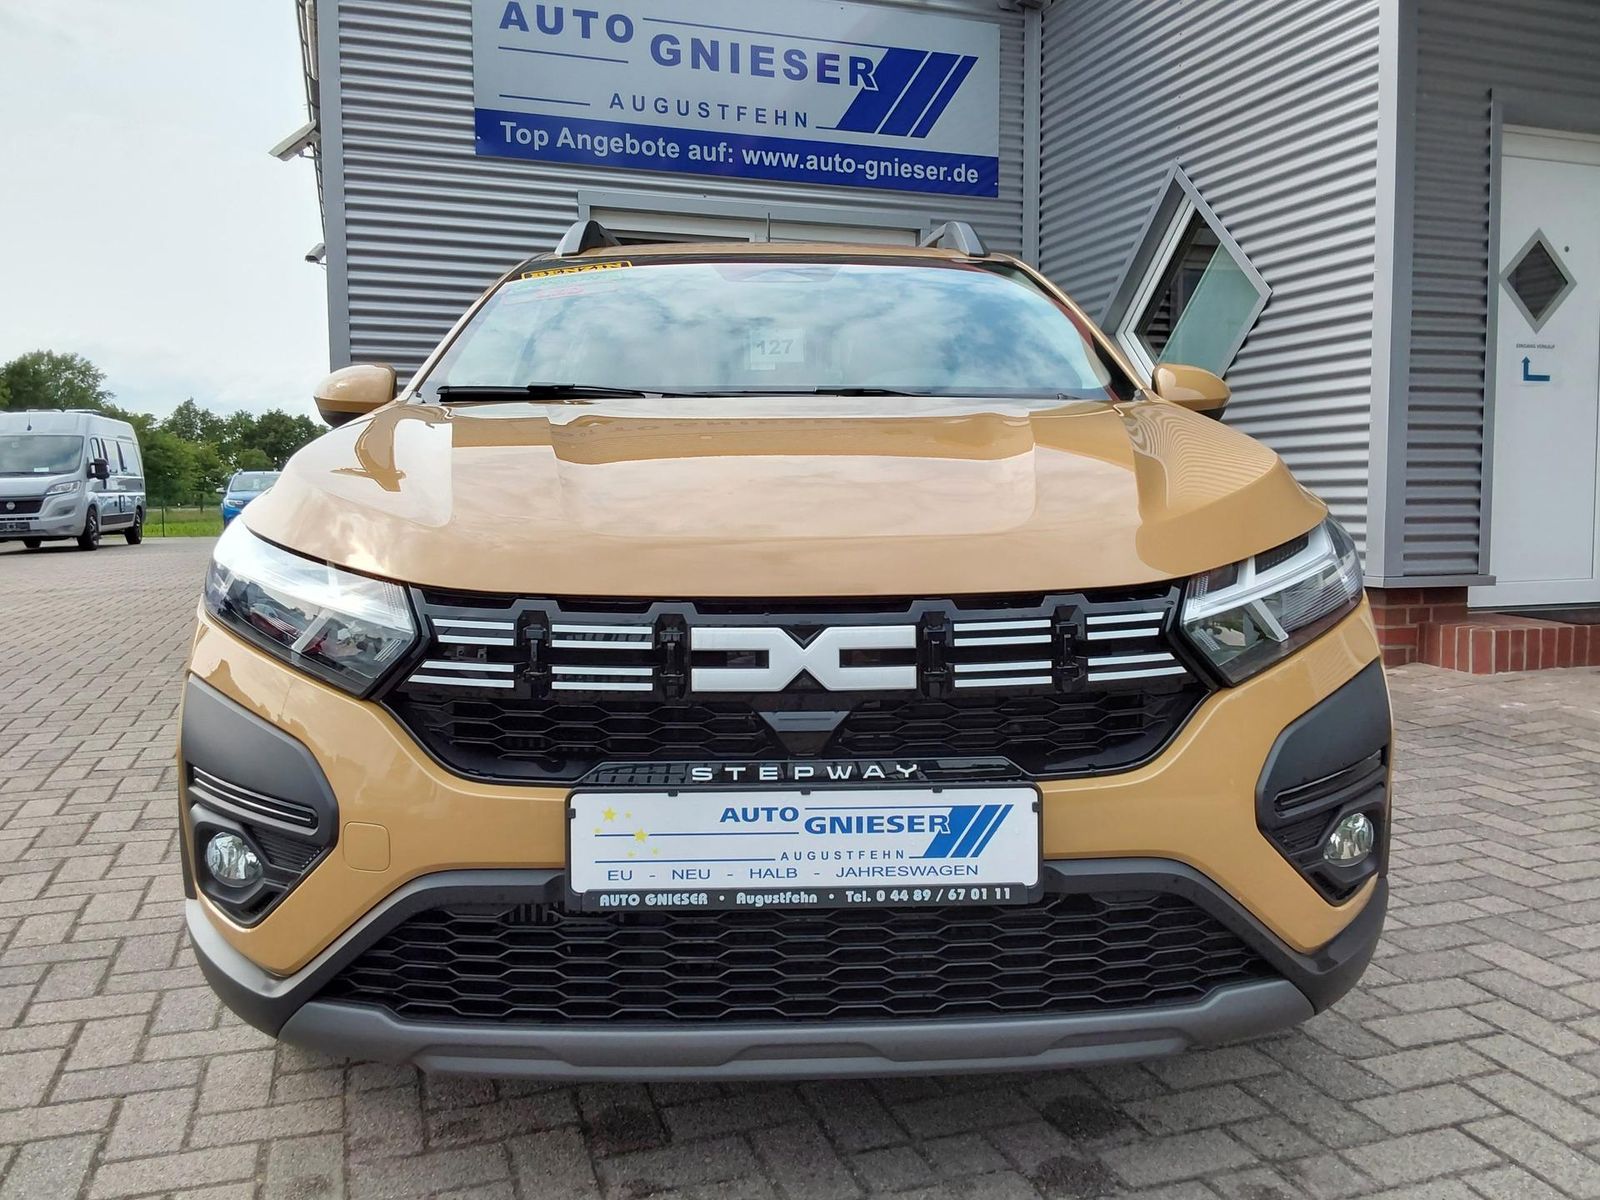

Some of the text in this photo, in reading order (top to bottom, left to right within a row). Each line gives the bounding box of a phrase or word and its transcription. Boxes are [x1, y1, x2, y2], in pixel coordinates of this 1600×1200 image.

[499, 1, 879, 91] AUTO GNIESER
[608, 92, 808, 128] AUGUSTFEHN
[499, 121, 979, 184] Top Angebote auf: www.auto-gnieser.de
[755, 339, 795, 355] 127
[691, 764, 918, 782] STEPWAY
[719, 806, 951, 835] AUTO GNIESER
[780, 849, 905, 861] AUGUSTFEHN
[607, 869, 633, 881] EU
[671, 868, 711, 881] NEU
[749, 867, 799, 879] HALB
[835, 864, 979, 878] JAHRESWAGEN
[599, 893, 641, 907] AUTO
[644, 892, 708, 906] GNIESER
[736, 891, 818, 907] Augustfehn
[846, 890, 871, 903] Tel.
[890, 889, 909, 902] 44
[913, 889, 931, 902] 89
[948, 888, 966, 901] 67
[970, 887, 988, 901] 01
[994, 887, 1011, 899] 11
